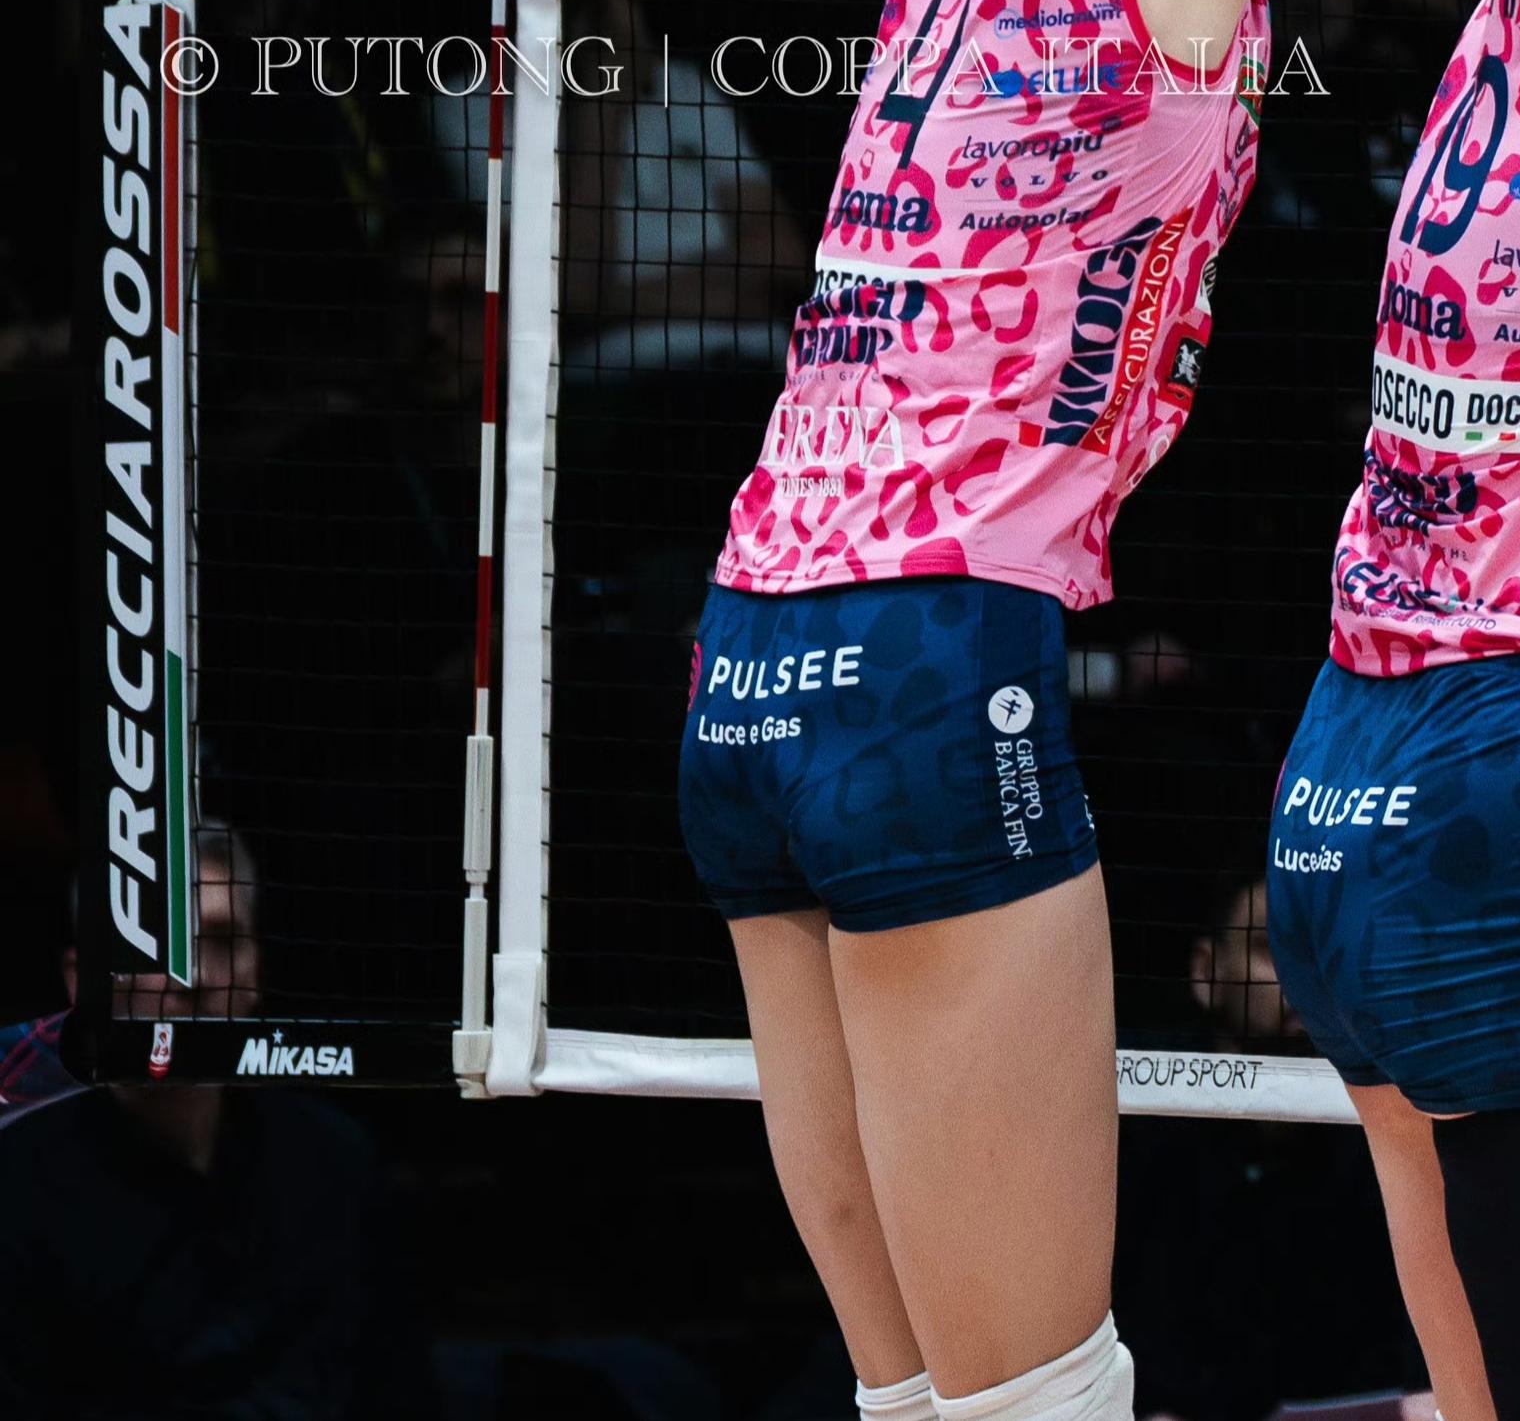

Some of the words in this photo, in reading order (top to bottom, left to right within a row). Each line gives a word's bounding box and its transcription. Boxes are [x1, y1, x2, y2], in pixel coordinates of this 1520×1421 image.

[1400, 55, 1509, 254] 19
[102, 1, 158, 961] FRECCIAROSSA
[707, 644, 864, 701] PULSEE
[697, 714, 747, 747] Luce
[761, 715, 802, 743] Gas
[1283, 775, 1418, 827] PULSEE
[236, 1036, 354, 1076] MIKASA
